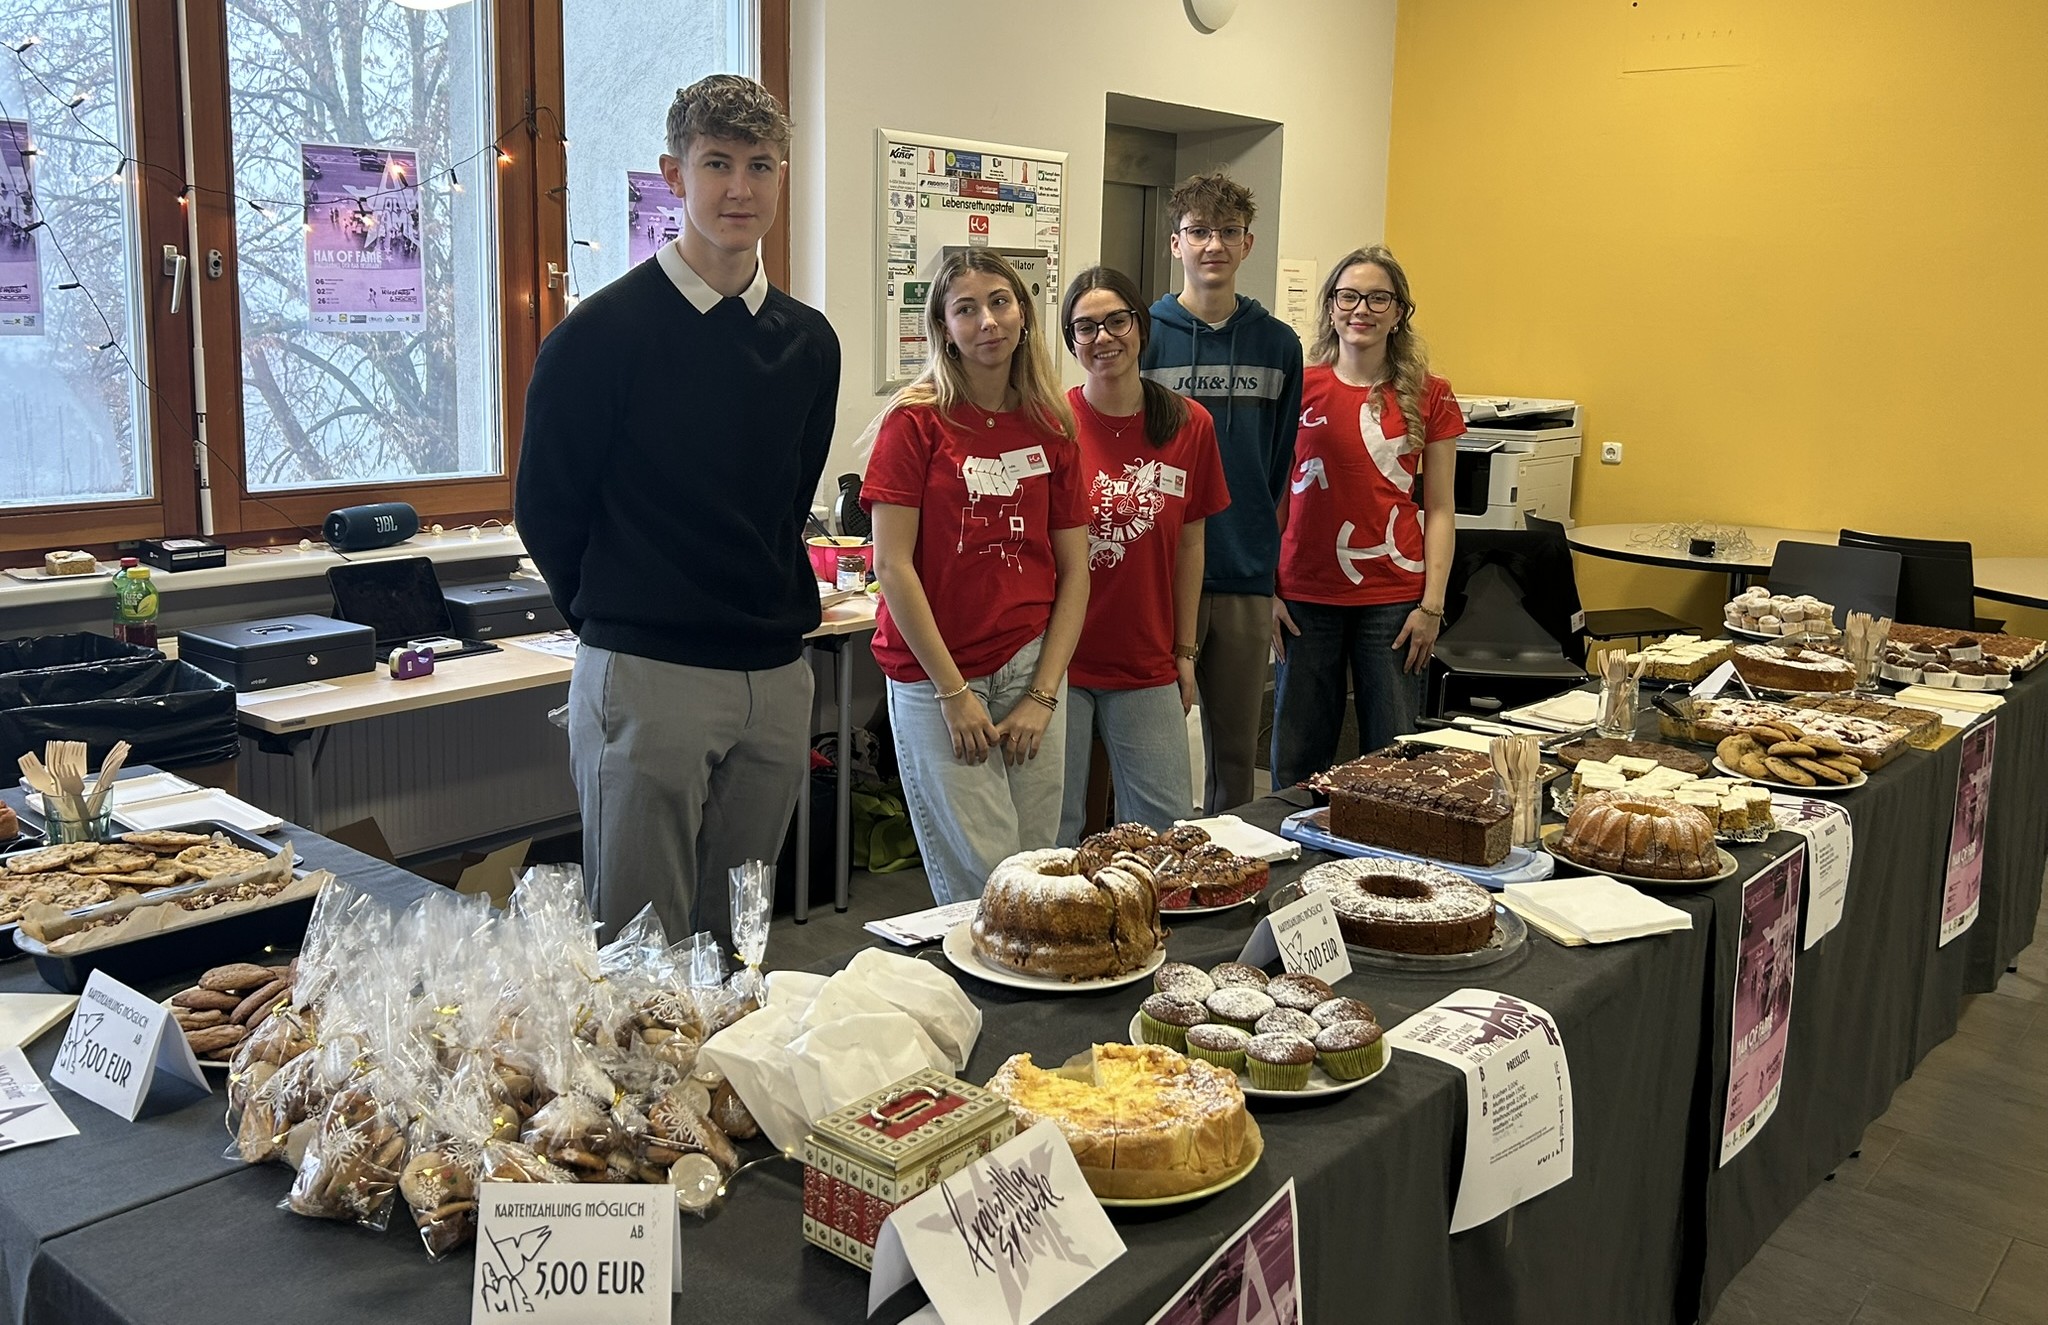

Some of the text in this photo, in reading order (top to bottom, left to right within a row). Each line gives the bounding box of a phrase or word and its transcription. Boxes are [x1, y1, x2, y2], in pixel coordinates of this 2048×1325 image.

[942, 196, 1015, 214] Lebensrettungstafel
[313, 249, 382, 263] HAK OF FAME
[1010, 260, 1035, 270] illator
[374, 515, 398, 533] JBL
[1321, 937, 1340, 963] EUR
[1416, 1025, 1451, 1044] BUFFET
[1449, 1035, 1478, 1055] BUFFET
[78, 1039, 132, 1088] 5,00 EUR
[494, 1200, 645, 1218] KARTENZAHLUNG MÖGLICH
[630, 1225, 644, 1239] AB
[534, 1260, 646, 1300] 5,00 EUR
